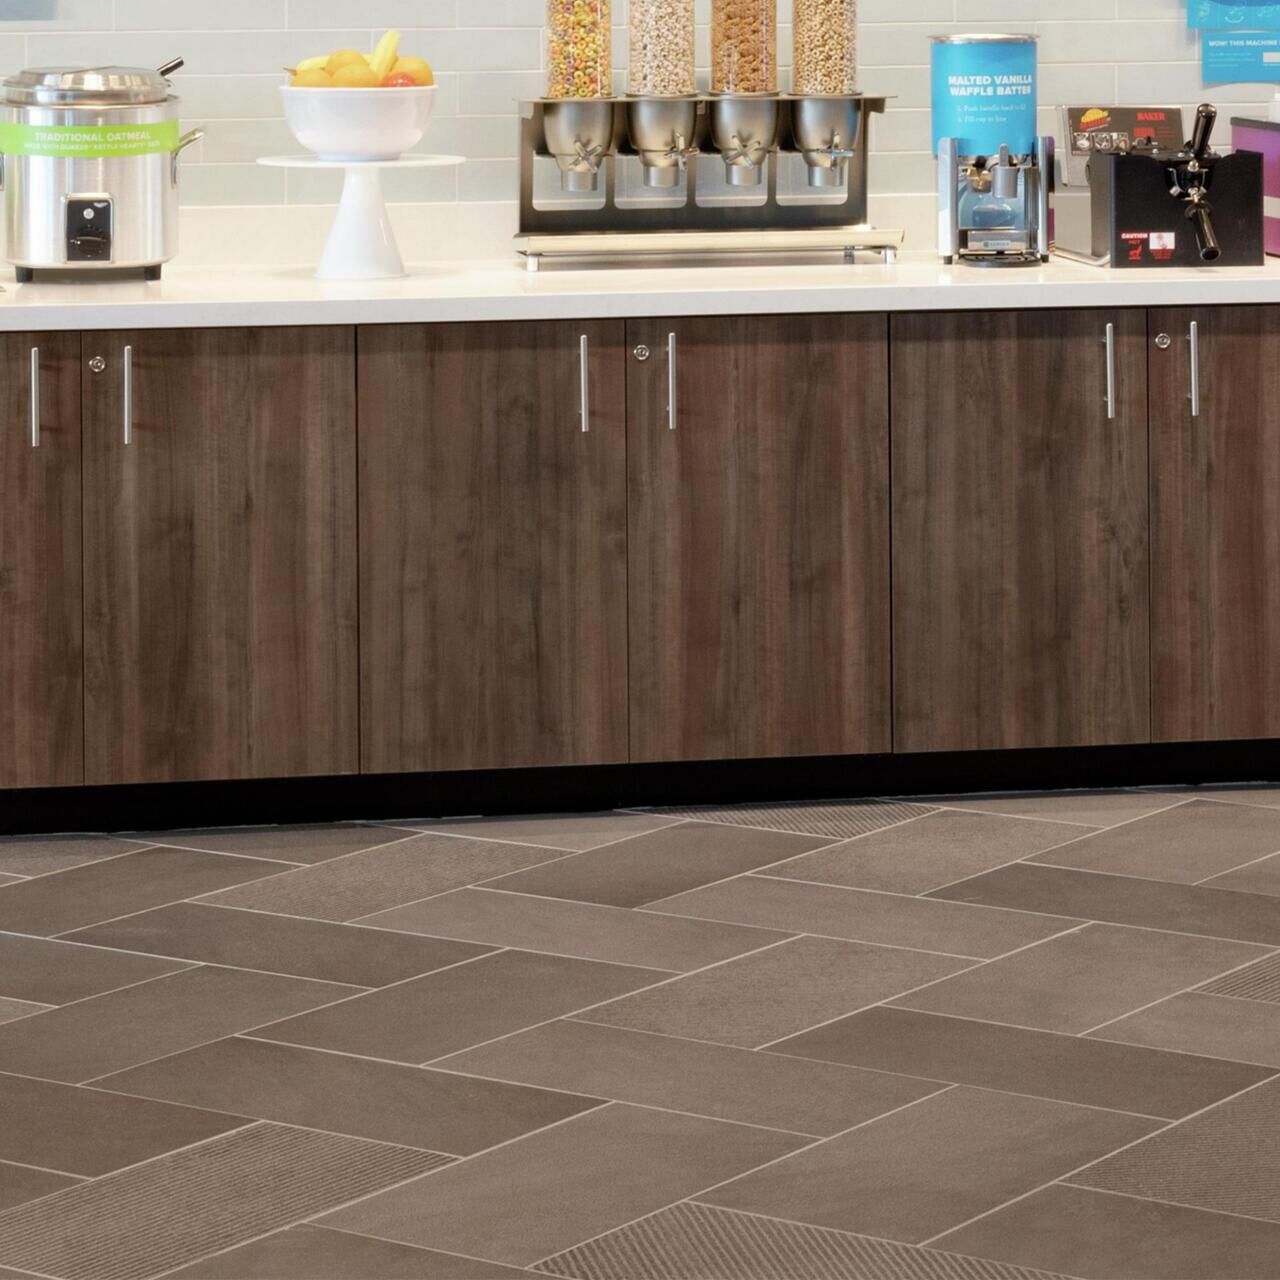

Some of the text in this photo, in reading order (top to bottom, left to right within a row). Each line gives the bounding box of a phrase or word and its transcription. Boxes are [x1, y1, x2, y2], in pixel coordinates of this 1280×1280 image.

[948, 75, 992, 85] MALTED
[950, 86, 994, 96] WAFFLE
[1137, 111, 1167, 121] BAKER
[34, 130, 152, 142] TRADITIONAL OATMEAL
